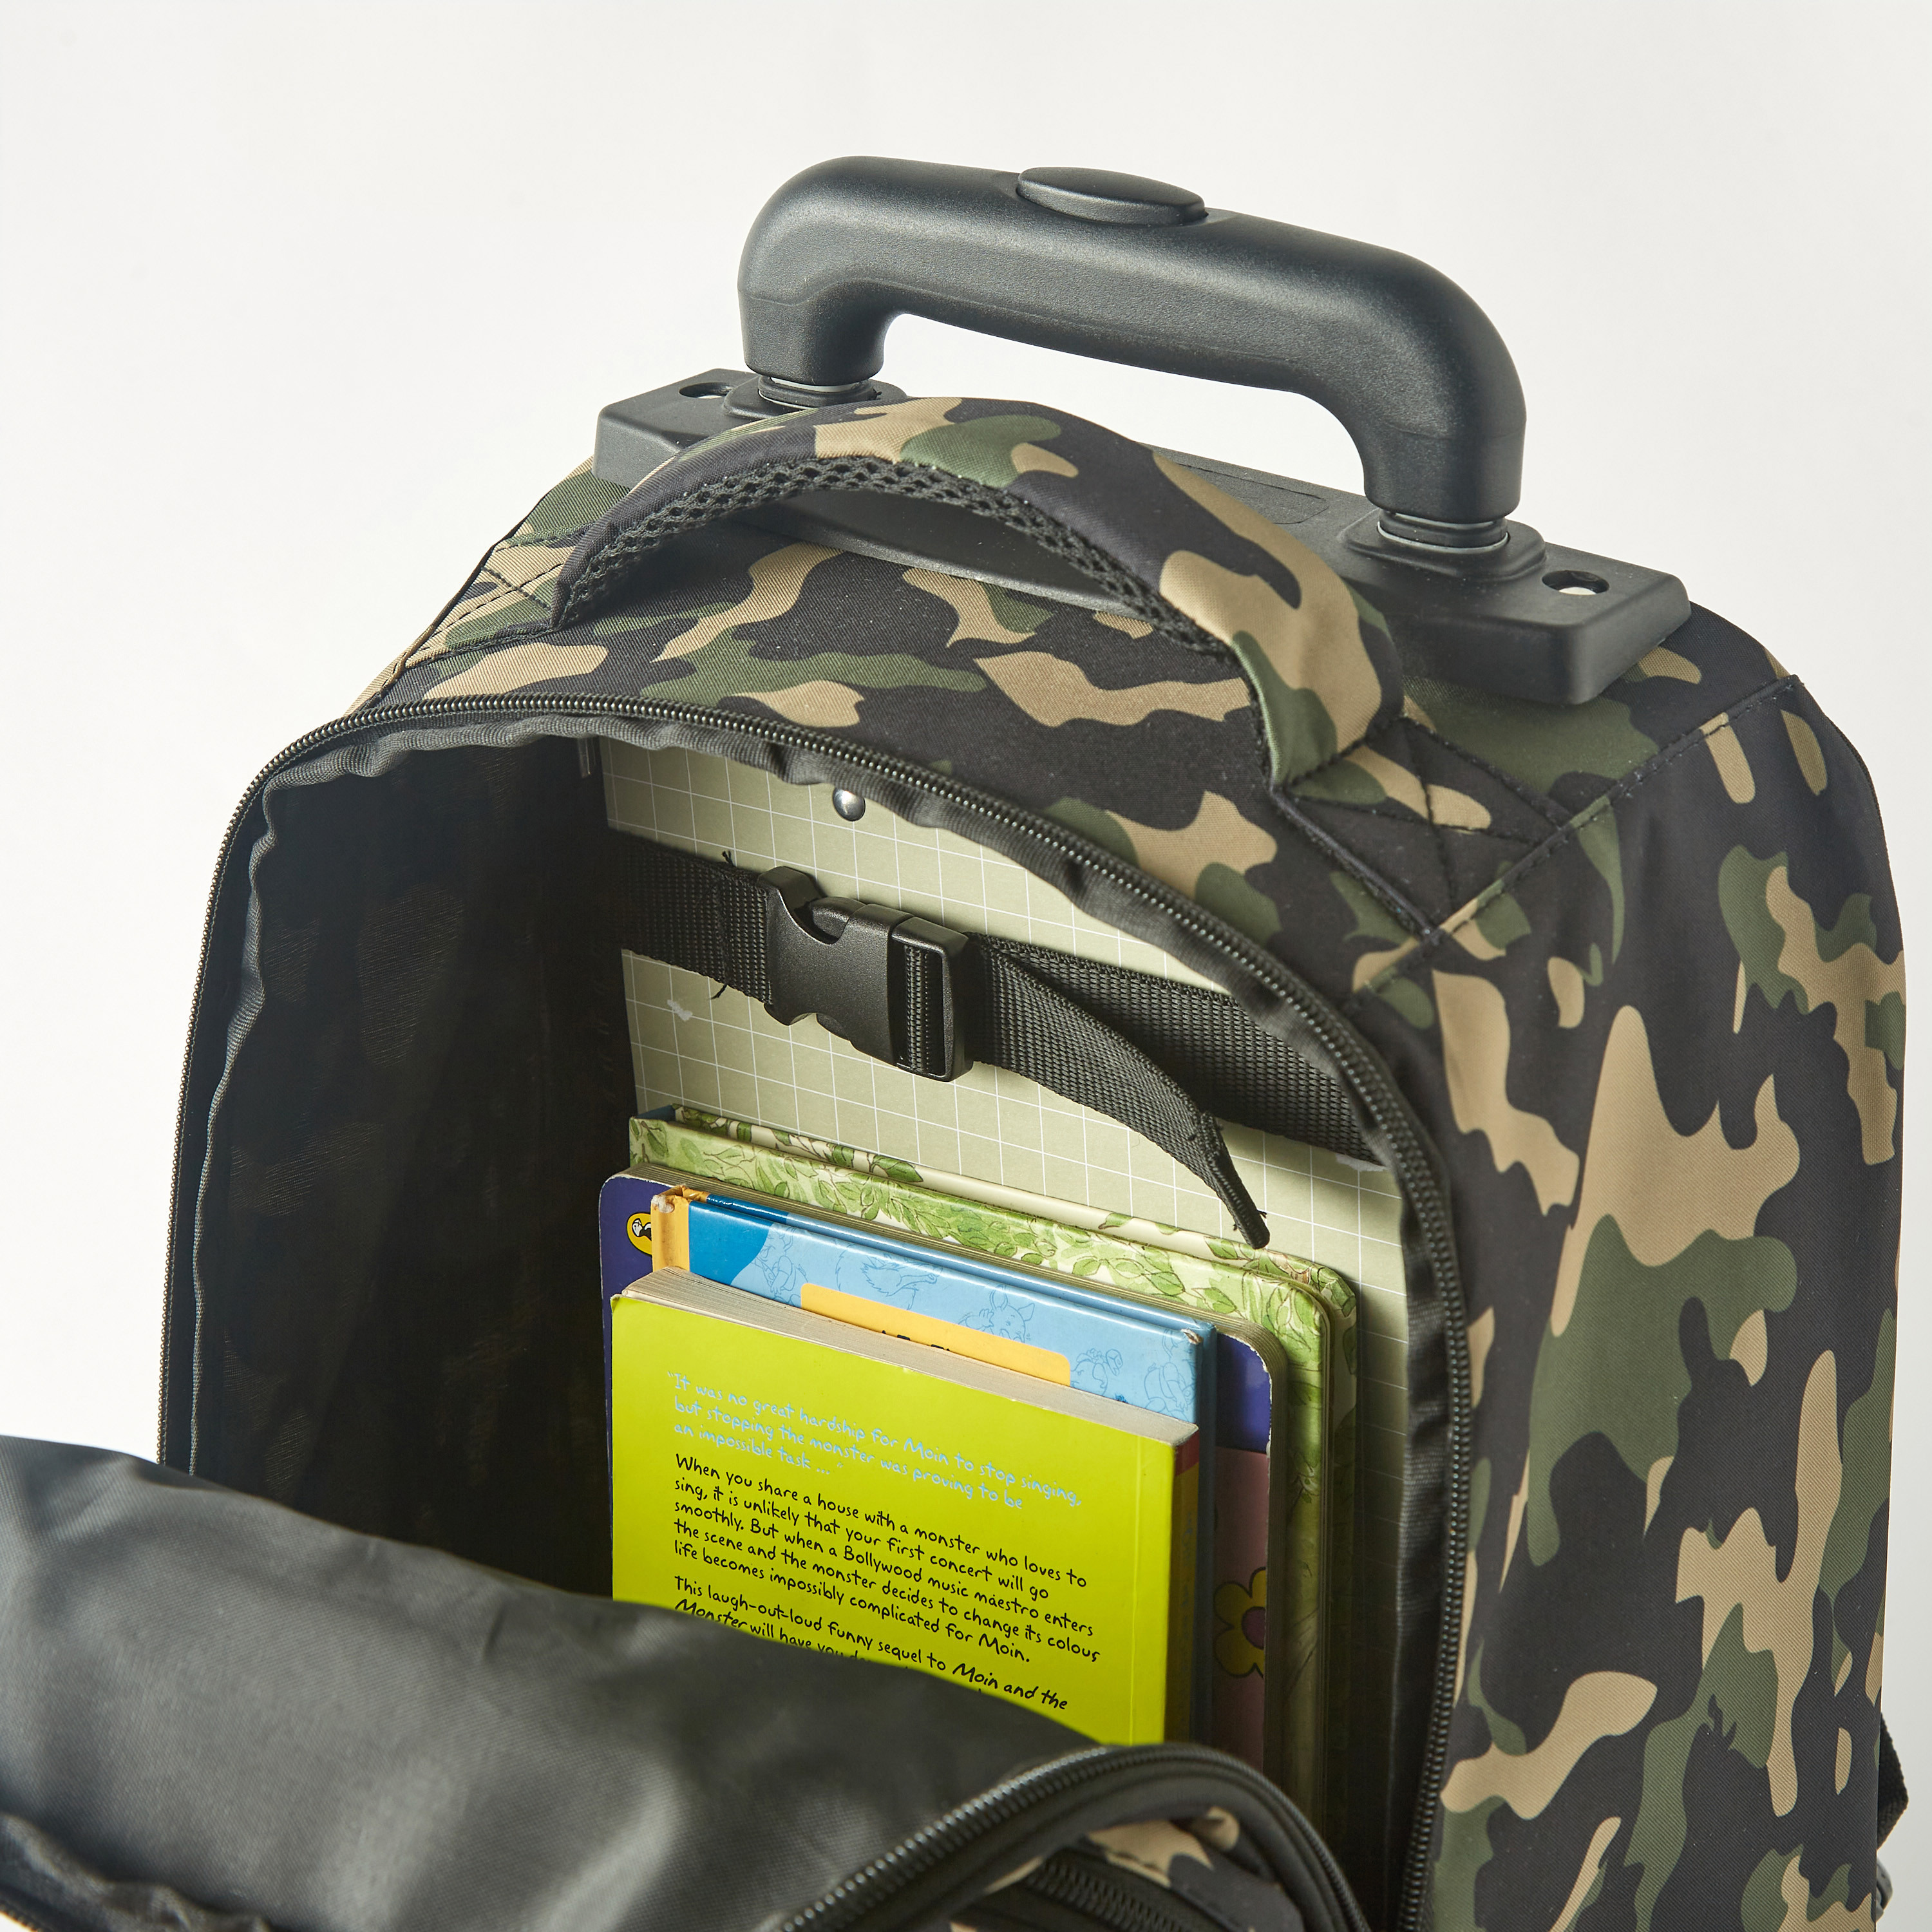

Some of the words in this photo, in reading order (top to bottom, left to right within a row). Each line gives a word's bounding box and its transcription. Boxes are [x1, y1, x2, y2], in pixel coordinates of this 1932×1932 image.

[674, 1425, 694, 1437] an
[699, 1425, 772, 1458] impossible
[777, 1446, 810, 1469] task
[675, 1396, 702, 1416] but
[707, 1406, 773, 1441] stopping
[779, 1424, 804, 1444] the
[810, 1438, 875, 1463] monster
[881, 1460, 907, 1475] was
[913, 1468, 973, 1499] proving
[978, 1482, 998, 1501] to
[1005, 1490, 1022, 1509] be
[696, 1386, 723, 1400] was
[728, 1393, 748, 1406] no
[753, 1400, 795, 1419] great
[800, 1408, 865, 1442] hardship
[871, 1428, 898, 1447] for
[904, 1438, 949, 1465] Moin
[954, 1452, 974, 1471] to
[980, 1462, 1016, 1486] stop
[1021, 1475, 1081, 1506] singing,
[674, 1502, 744, 1532] smoothly.
[750, 1518, 779, 1539] But
[784, 1531, 824, 1553] when
[829, 1547, 838, 1557] a
[843, 1545, 922, 1582] Bollywood
[927, 1577, 969, 1596] music
[1044, 1612, 1093, 1636] enters
[674, 1518, 699, 1539] the
[704, 1532, 743, 1551] scene
[747, 1546, 776, 1560] and
[781, 1548, 807, 1569] the
[812, 1563, 876, 1589] monster
[882, 1580, 934, 1609] decides
[938, 1597, 958, 1616] to
[963, 1607, 1019, 1639] change
[1025, 1624, 1041, 1643] its
[675, 1475, 708, 1501] sing,
[713, 1486, 724, 1501] it
[729, 1490, 739, 1506] is
[744, 1499, 800, 1526] unlikely
[804, 1511, 840, 1535] that
[846, 1528, 882, 1546] your
[886, 1537, 925, 1561] first
[930, 1555, 993, 1582] concert
[998, 1575, 1023, 1591] will
[1029, 1586, 1048, 1602] go
[676, 1453, 720, 1480] When
[726, 1472, 752, 1487] you
[757, 1478, 798, 1501] share
[803, 1495, 812, 1506] a
[817, 1493, 859, 1519] house
[864, 1510, 895, 1531] with
[900, 1524, 909, 1535] a
[914, 1528, 981, 1554] monster
[986, 1548, 1018, 1567] who
[1025, 1555, 1061, 1581] loves
[1066, 1568, 1086, 1587] to
[674, 1539, 697, 1560] life
[703, 1547, 764, 1579] becomes
[770, 1567, 844, 1605] impossibly
[849, 1596, 940, 1633] complicated
[945, 1623, 973, 1642] for
[978, 1633, 1030, 1663] Moin.
[674, 1598, 748, 1629] Monster
[750, 1622, 774, 1638] will
[780, 1627, 811, 1648] have
[674, 1575, 703, 1596] This
[708, 1584, 822, 1631] laugh-out-loud
[827, 1621, 873, 1651] funny
[878, 1642, 922, 1663] sequel
[926, 1652, 946, 1671] to
[952, 1663, 998, 1689] Moin
[1003, 1684, 1039, 1699] and
[1041, 1689, 1068, 1710] the
